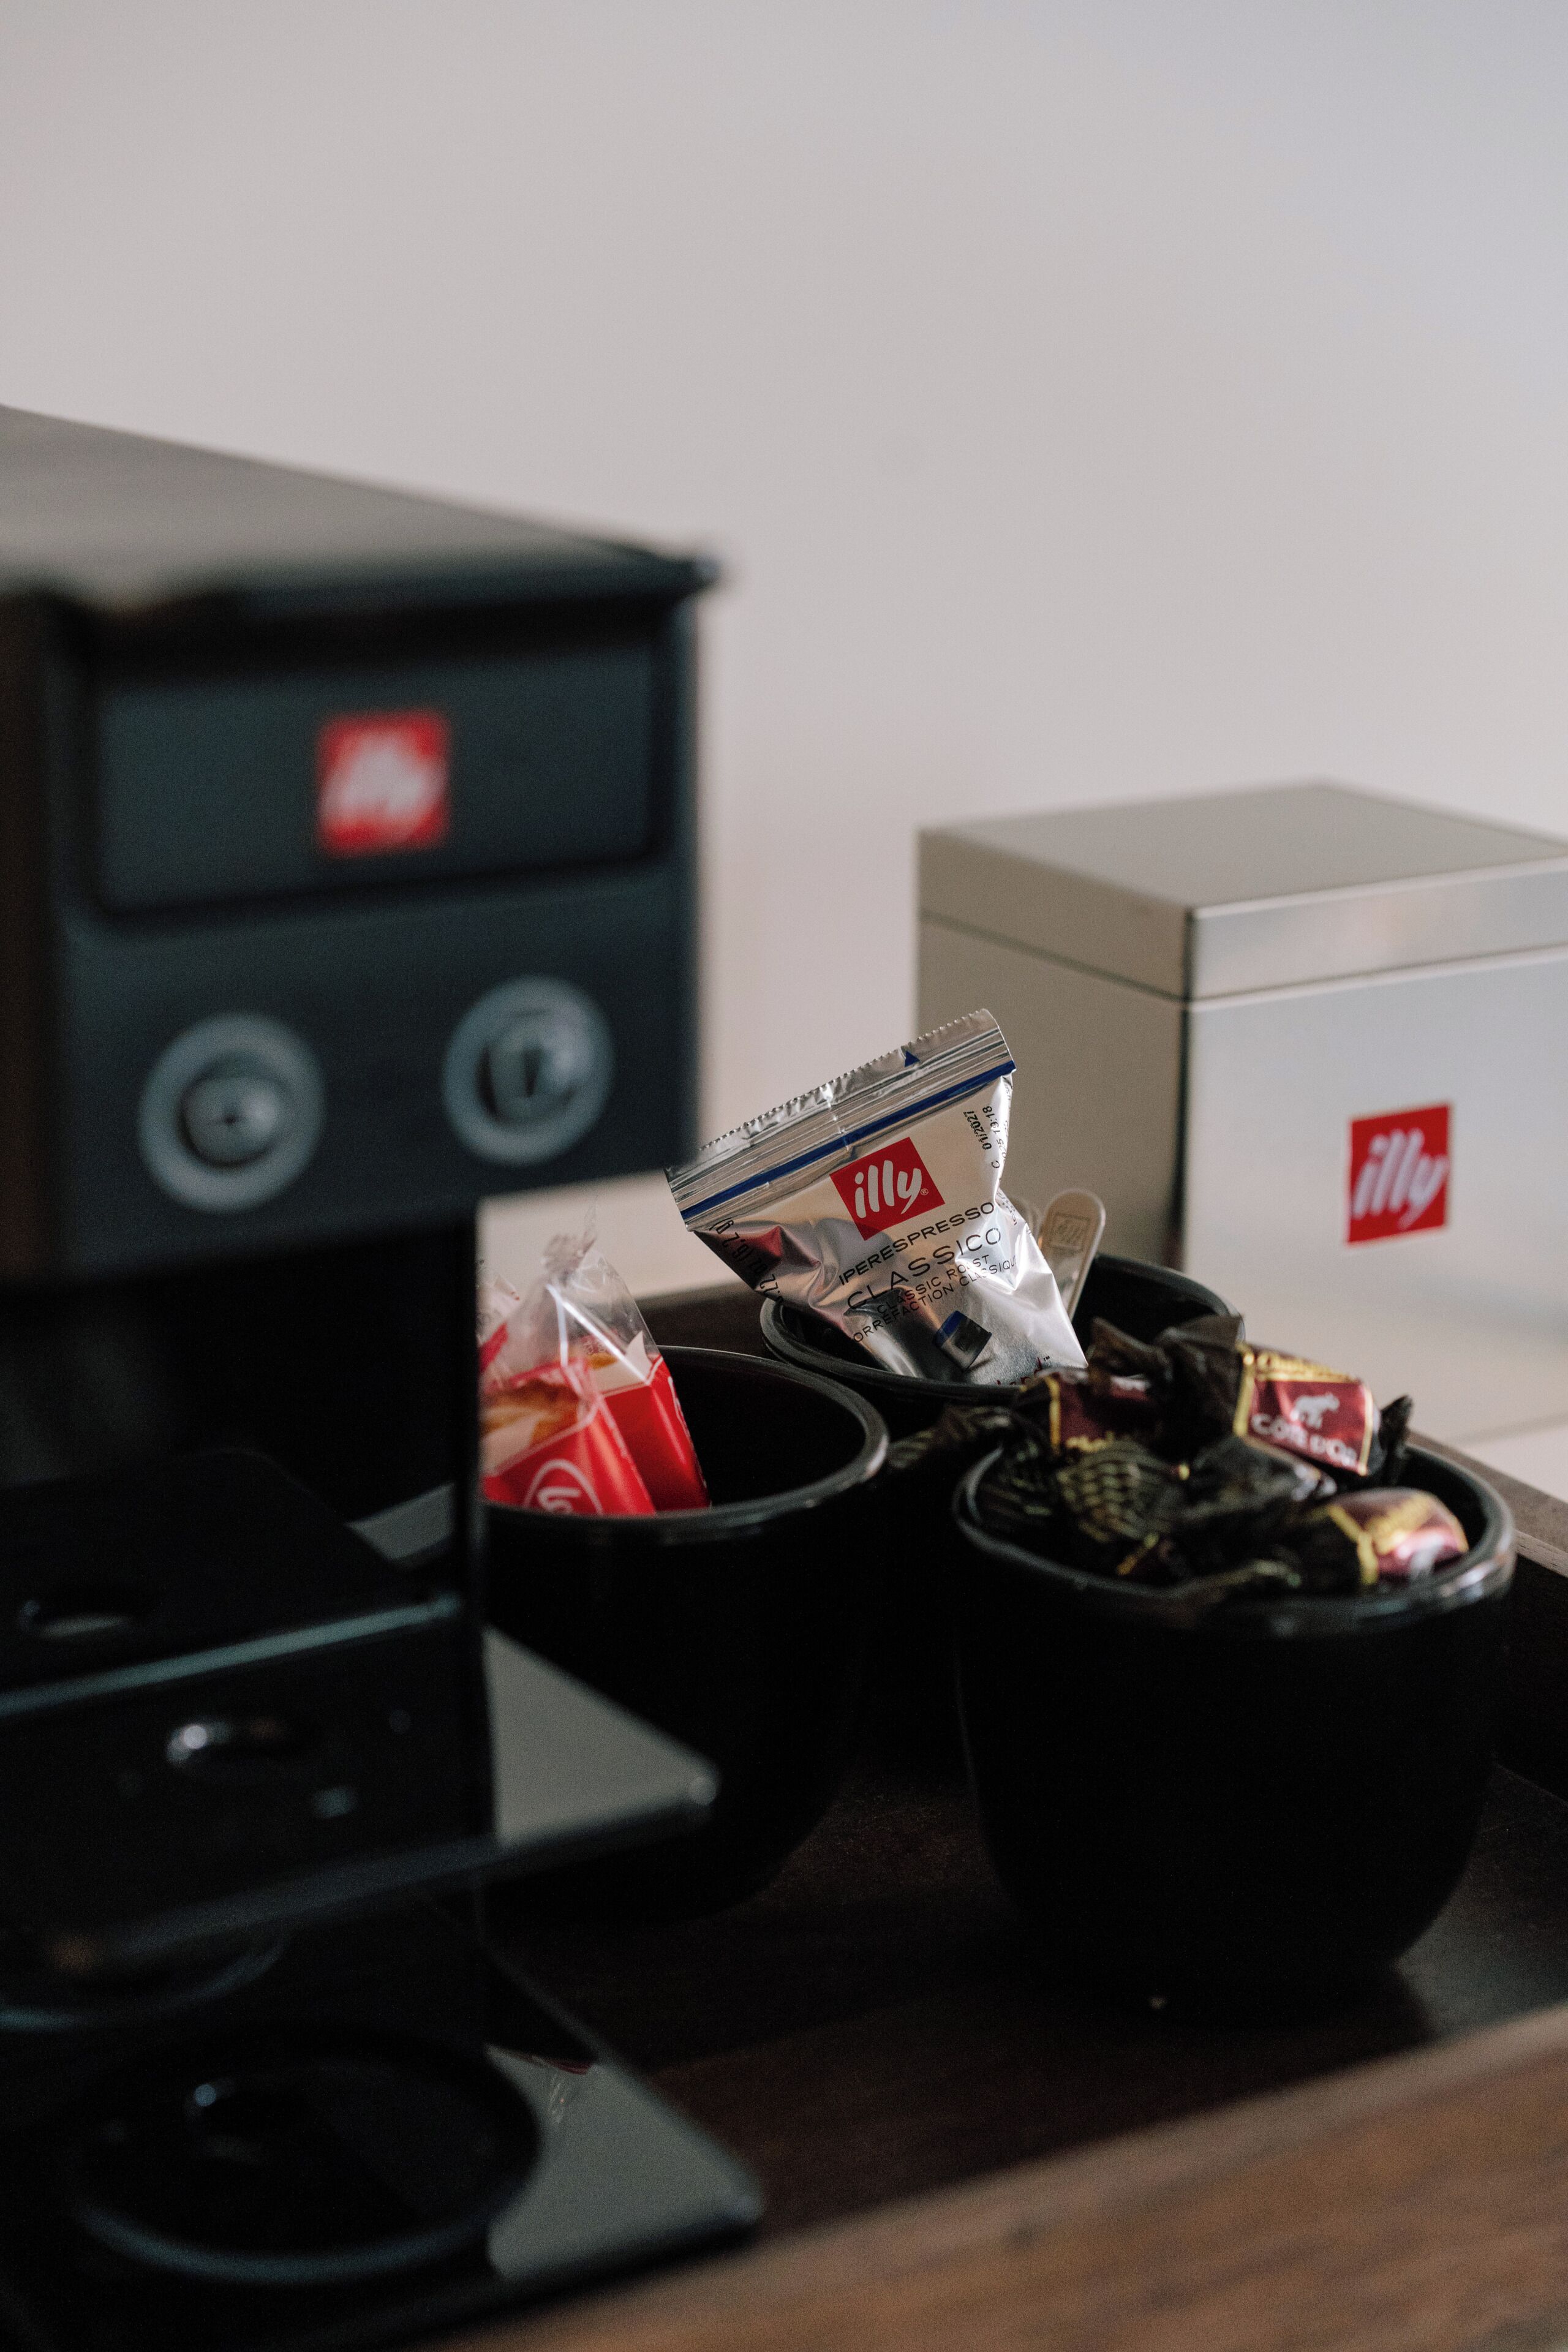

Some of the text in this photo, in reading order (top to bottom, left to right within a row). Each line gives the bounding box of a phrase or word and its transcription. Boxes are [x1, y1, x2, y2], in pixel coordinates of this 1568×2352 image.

[854, 1159, 922, 1219] illy
[1350, 1127, 1450, 1230] illy
[839, 1202, 995, 1286] IPERESPRESSO
[847, 1227, 1001, 1309] CLASSICO
[877, 1254, 990, 1314] CLASSIC ROST
[853, 1257, 1017, 1343] ORRÉFACTION CLASSIQU
